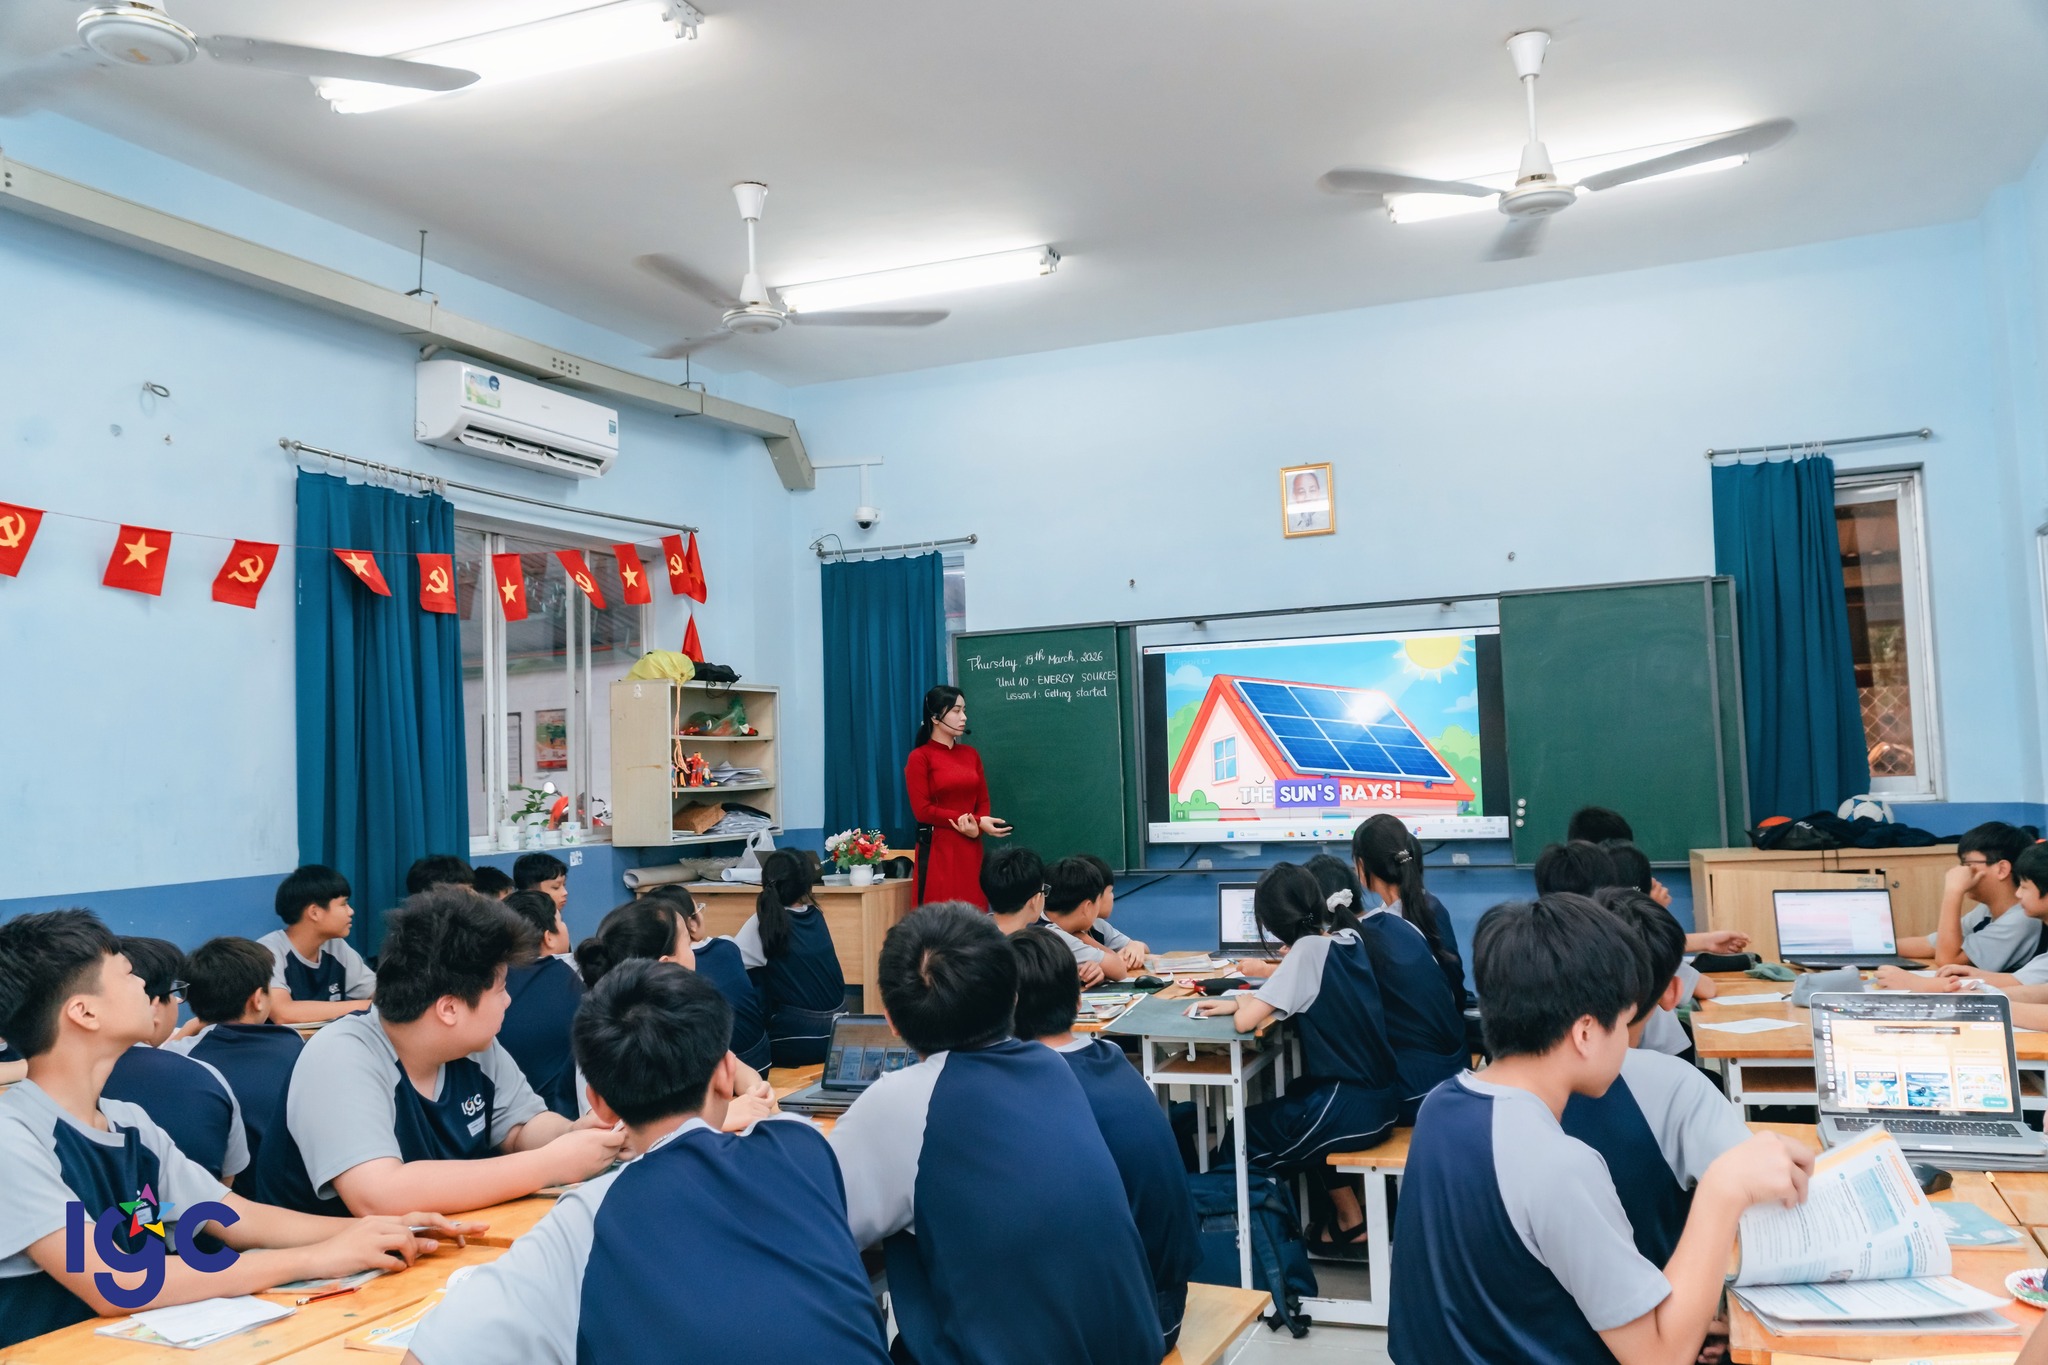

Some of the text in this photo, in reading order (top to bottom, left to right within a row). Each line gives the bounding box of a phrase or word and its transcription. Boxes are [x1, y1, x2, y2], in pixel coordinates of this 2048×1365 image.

[1025, 648, 1046, 666] 19th
[1080, 650, 1104, 663] 2026
[996, 677, 1016, 688] Unit
[1038, 673, 1075, 686] ENERGY
[1081, 670, 1117, 683] SOURCES
[1006, 691, 1031, 701] Lesson
[1044, 688, 1072, 703] Getting
[1076, 686, 1108, 698] started
[1240, 781, 1402, 803] THE SUN'S RAYS!
